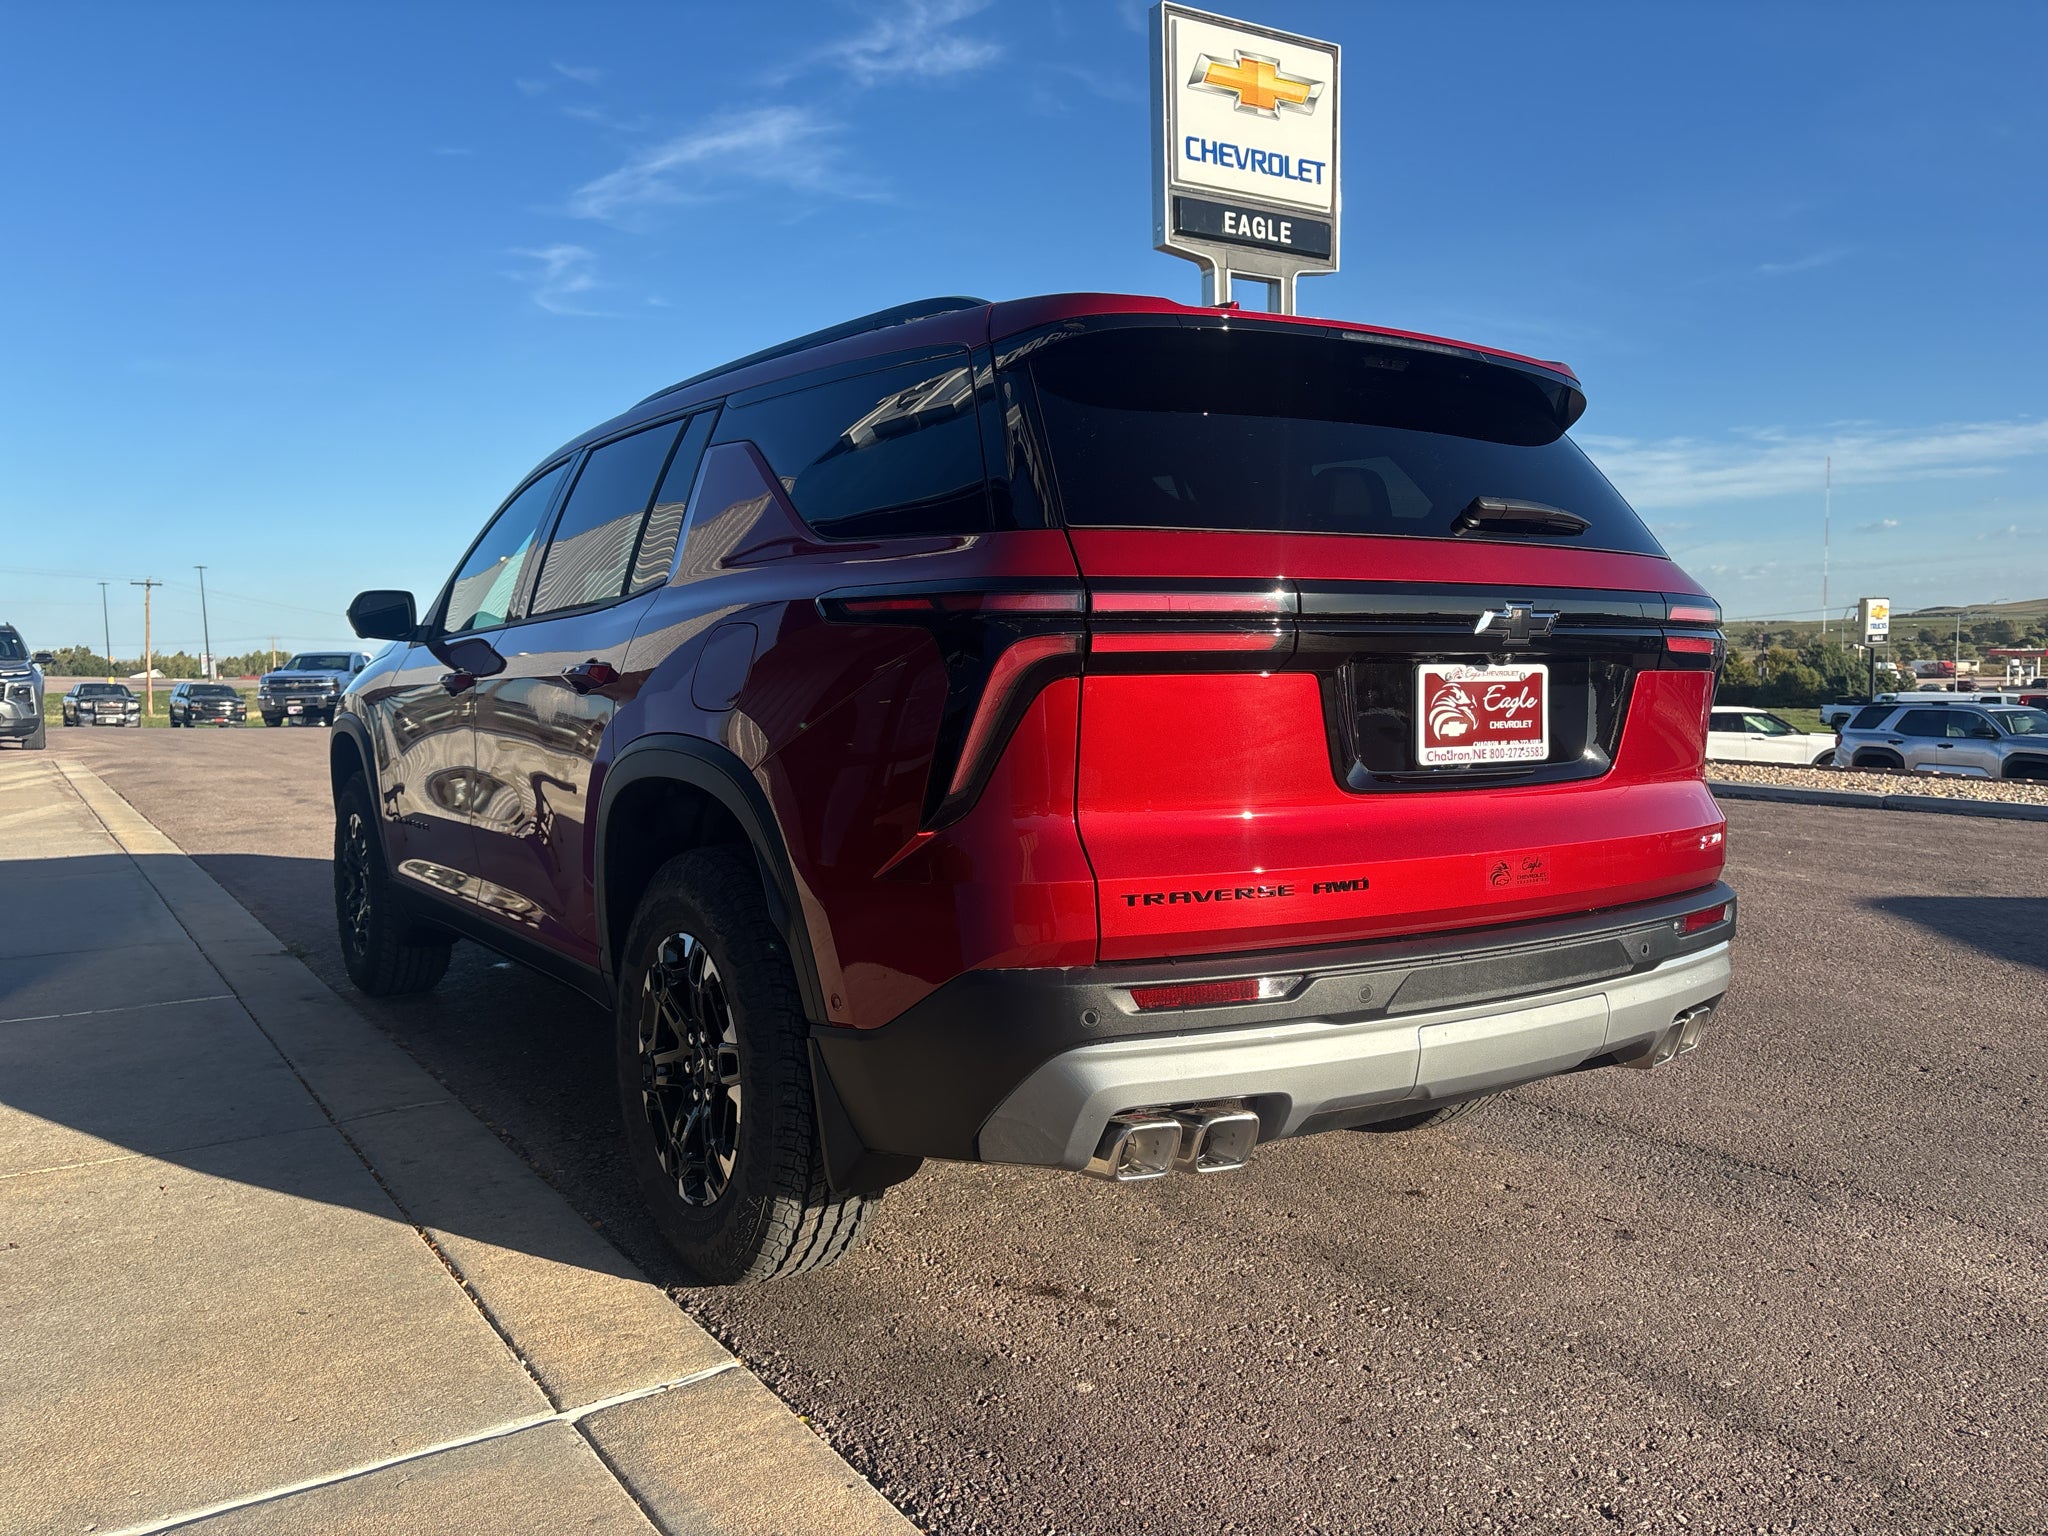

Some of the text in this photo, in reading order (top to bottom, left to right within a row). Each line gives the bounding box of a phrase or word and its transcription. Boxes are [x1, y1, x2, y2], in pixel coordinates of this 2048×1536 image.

[1185, 135, 1326, 185] CHEVROLET
[1223, 210, 1292, 244] EAGLE
[1483, 684, 1538, 718] Eagle
[1489, 720, 1533, 729] CHEVROLET
[1489, 746, 1544, 759] 800-272-5583
[1120, 877, 1370, 907] TRAVERSE AWD
